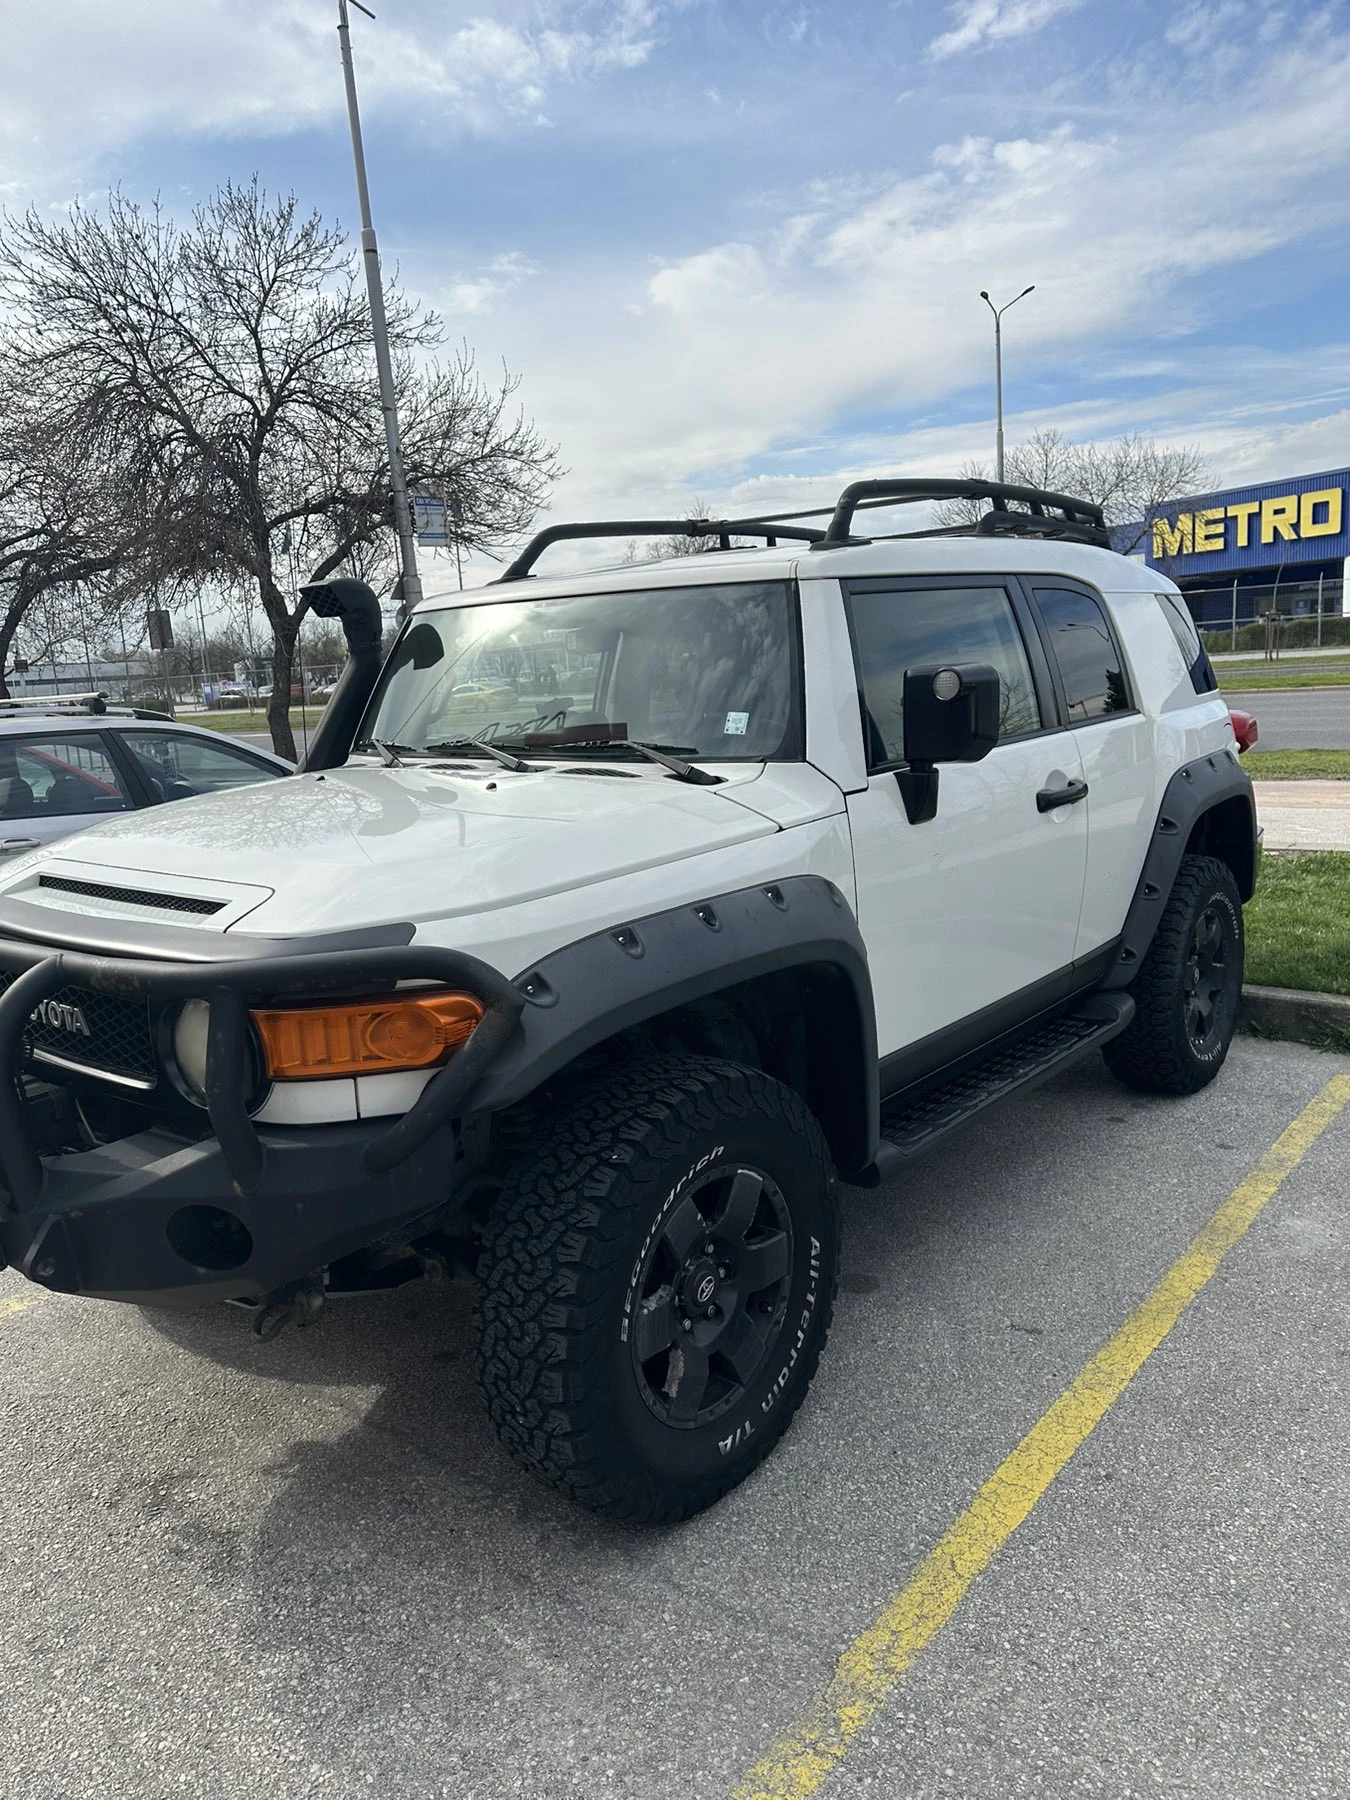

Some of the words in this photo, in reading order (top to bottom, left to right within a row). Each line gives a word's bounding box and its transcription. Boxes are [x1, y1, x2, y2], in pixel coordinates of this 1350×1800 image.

[1152, 487, 1342, 559] METRO
[29, 999, 91, 1037] YOTA
[620, 1144, 725, 1342] BFGoodrich
[761, 1235, 821, 1414] All-Terrain
[717, 1419, 756, 1456] T/A
